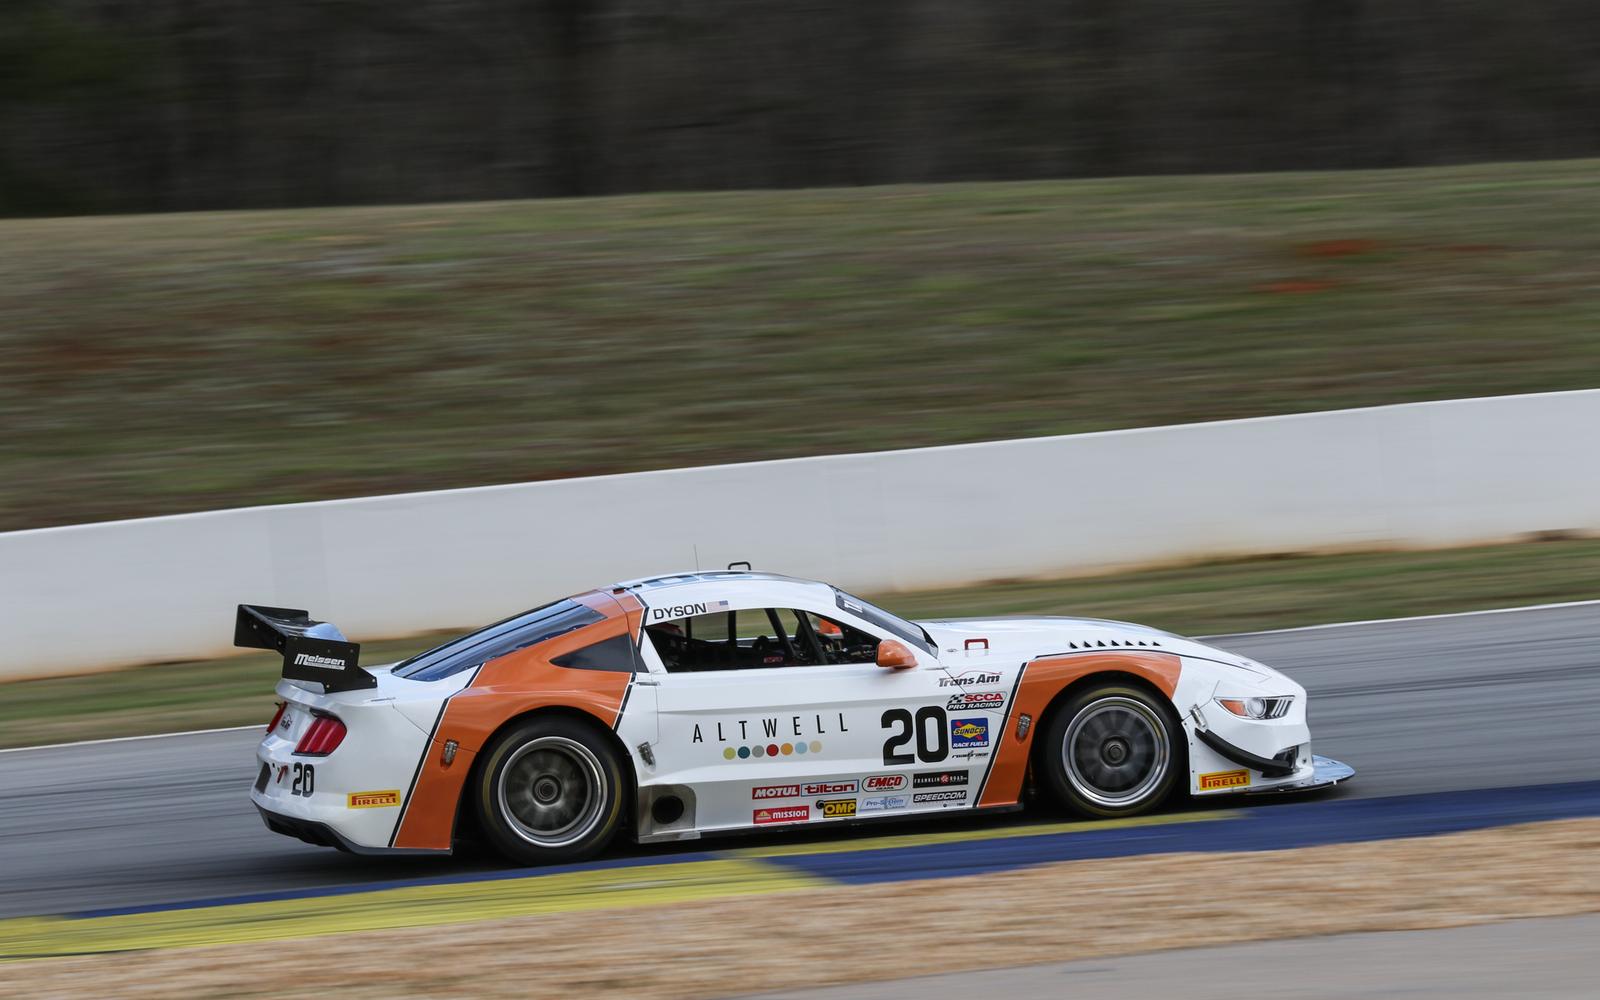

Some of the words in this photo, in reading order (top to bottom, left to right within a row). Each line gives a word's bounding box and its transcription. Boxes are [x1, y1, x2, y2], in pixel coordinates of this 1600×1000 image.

[653, 602, 707, 620] DYSON
[294, 653, 346, 666] Meissen
[939, 677, 975, 688] Trans
[976, 674, 1001, 684] Am
[965, 693, 1004, 702] SCCA
[880, 705, 949, 766] 20
[954, 727, 986, 736] SUNOCO
[969, 740, 988, 748] FUELS
[290, 761, 315, 798] 20
[868, 776, 903, 787] EMCO
[1200, 771, 1248, 788] PIRELLI
[754, 787, 798, 798] MOTUL
[805, 784, 856, 794] tilton
[351, 792, 397, 806] PIRELLI
[915, 791, 966, 802] SPEEDCOM
[824, 803, 856, 814] OMP
[773, 810, 807, 819] mission
